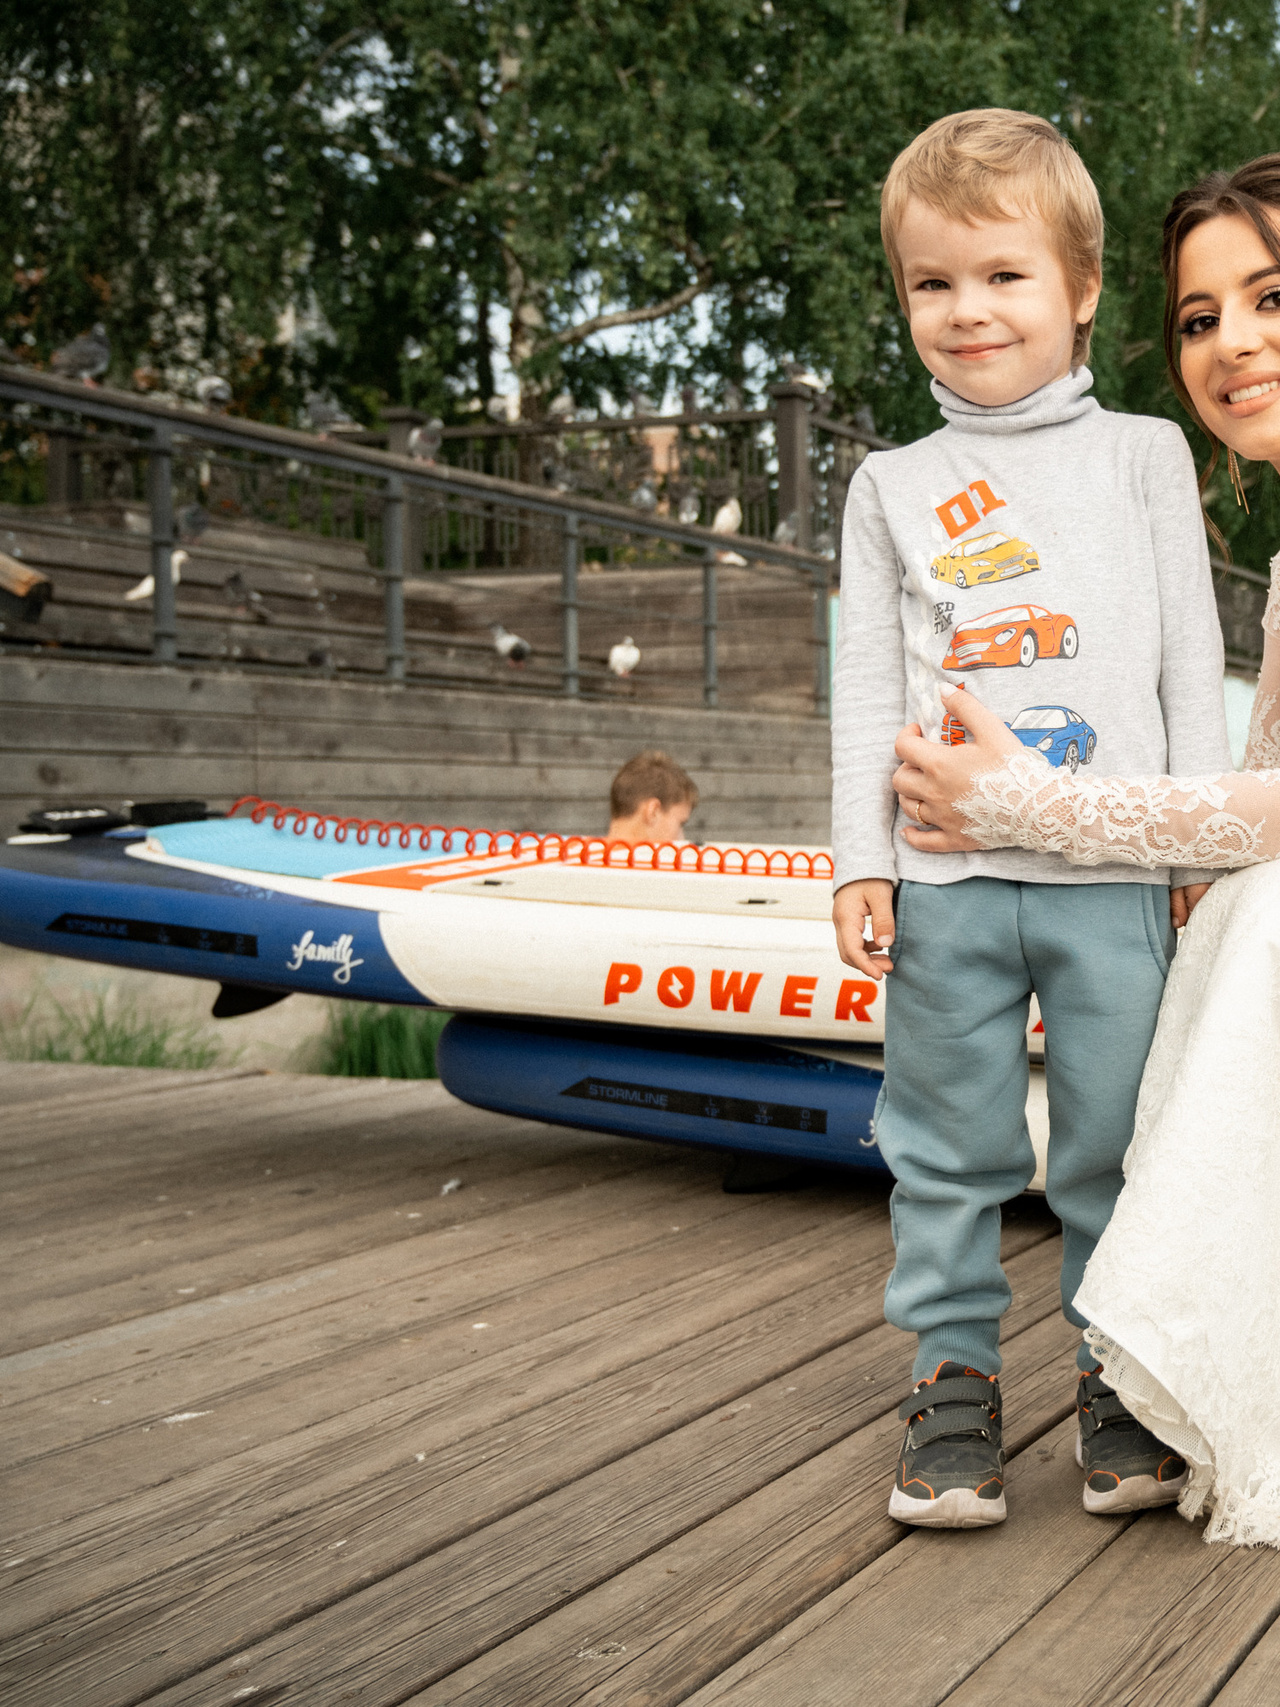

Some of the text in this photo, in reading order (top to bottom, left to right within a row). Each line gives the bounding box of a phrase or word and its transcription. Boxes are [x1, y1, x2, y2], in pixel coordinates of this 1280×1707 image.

[935, 480, 1007, 540] 01
[286, 929, 364, 985] family
[603, 962, 879, 1023] POWER
[589, 1083, 669, 1108] STORMLINE
